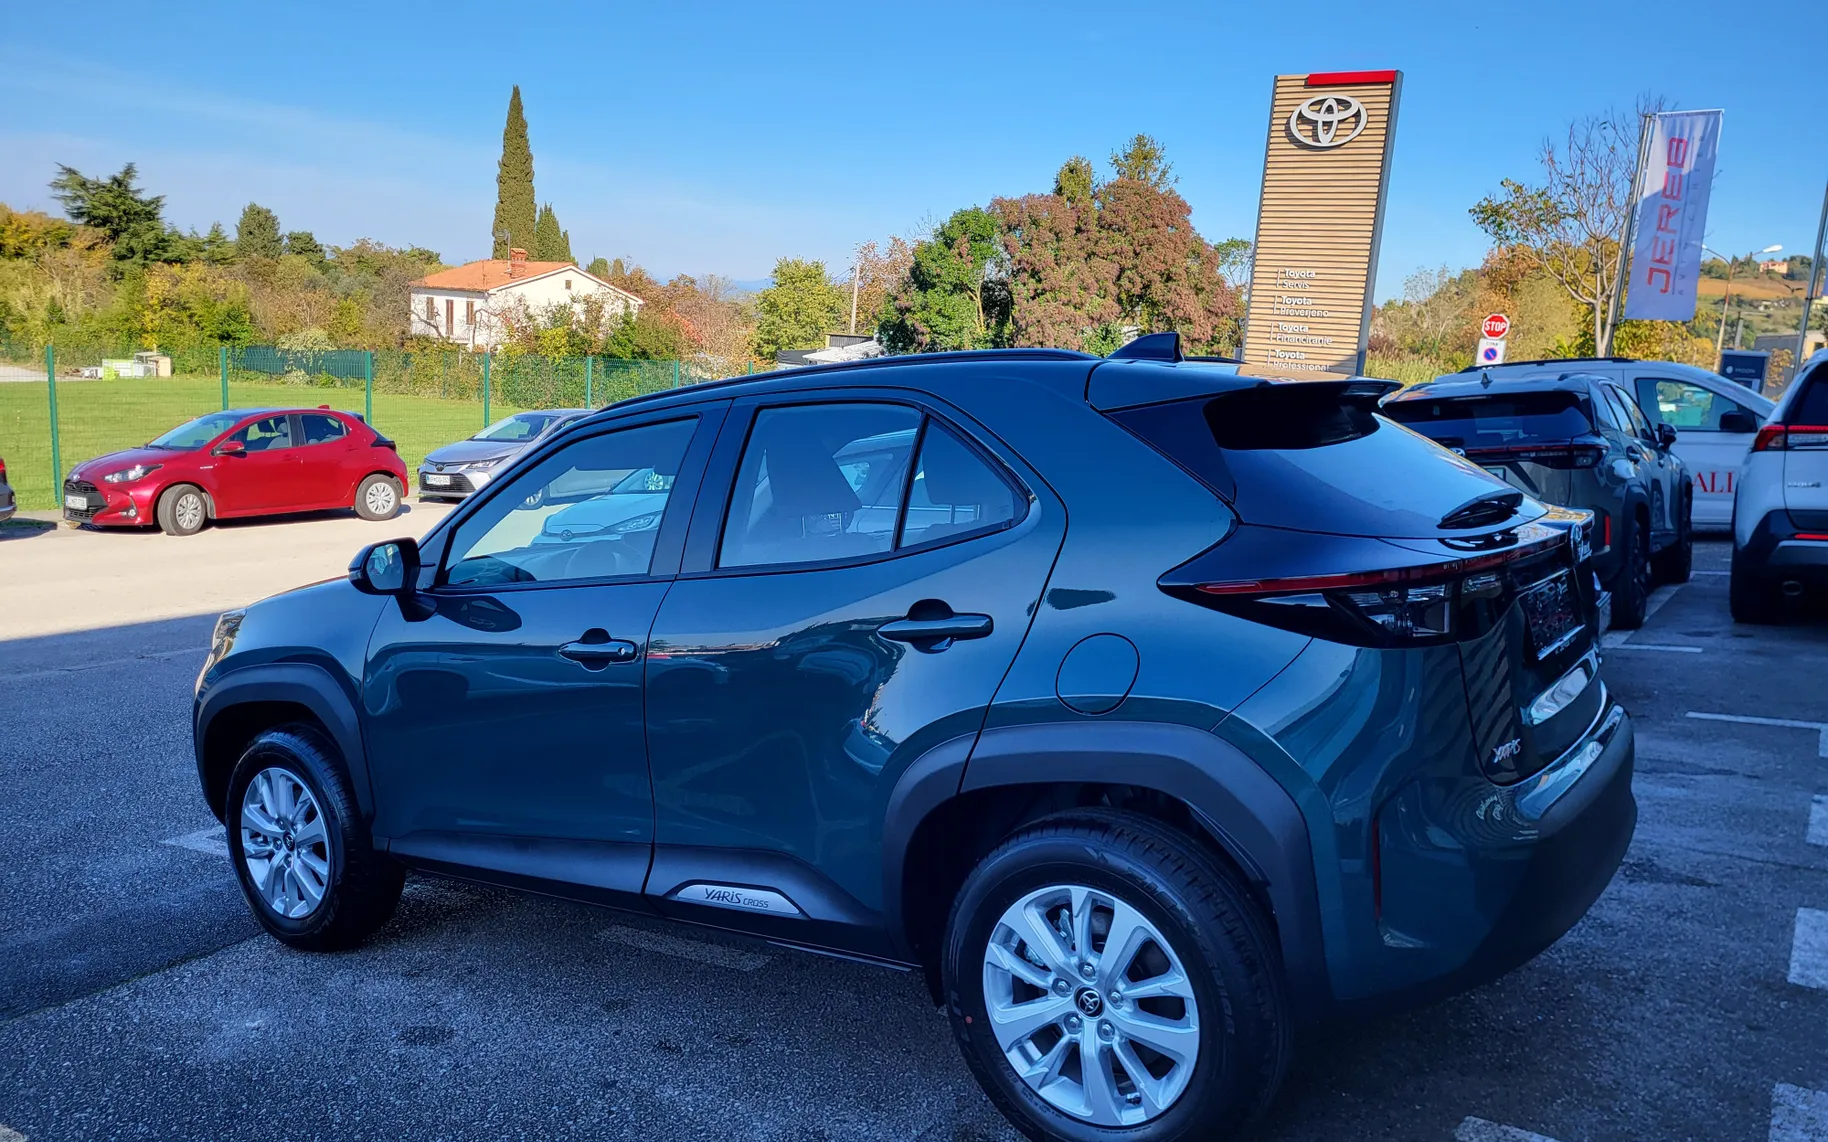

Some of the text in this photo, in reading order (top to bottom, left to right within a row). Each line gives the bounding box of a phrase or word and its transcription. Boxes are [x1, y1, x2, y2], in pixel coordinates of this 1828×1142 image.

[1648, 137, 1688, 294] JEREB
[1284, 268, 1316, 279] Toyota
[1282, 280, 1310, 290] Servis
[1281, 295, 1313, 306] Toyota
[1280, 307, 1329, 319] Preverjeno
[1278, 322, 1309, 333] Toyota
[1484, 321, 1507, 332] STOP
[1276, 334, 1333, 347] Financiranje
[1274, 349, 1306, 360] Toyota
[1273, 361, 1330, 372] Professional
[1692, 471, 1735, 493] ALI
[705, 888, 769, 908] YARIS CROSS
